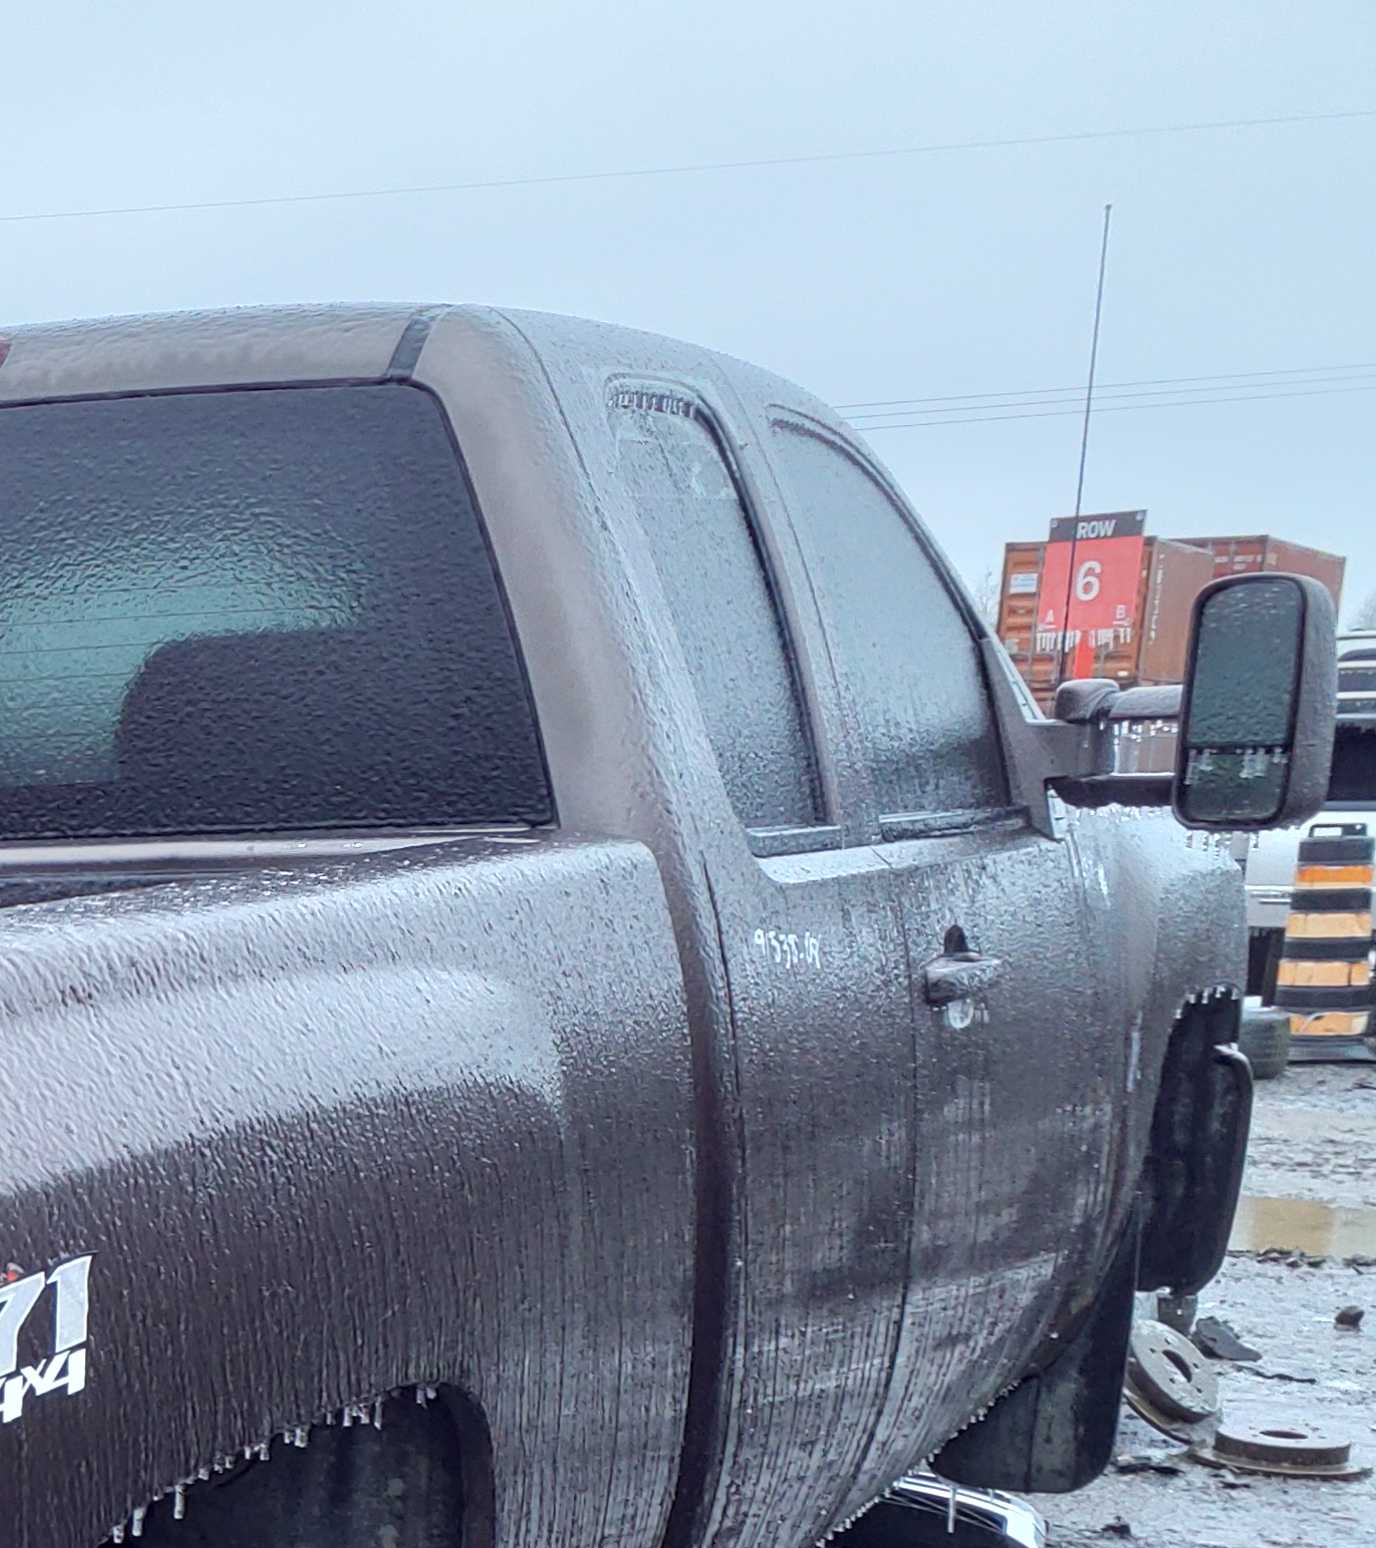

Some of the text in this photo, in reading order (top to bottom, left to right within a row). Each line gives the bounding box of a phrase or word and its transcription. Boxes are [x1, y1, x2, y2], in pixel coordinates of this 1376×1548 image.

[1076, 519, 1116, 539] ROW
[1075, 560, 1103, 602] 6
[1045, 609, 1055, 623] A
[1115, 604, 1126, 618] B
